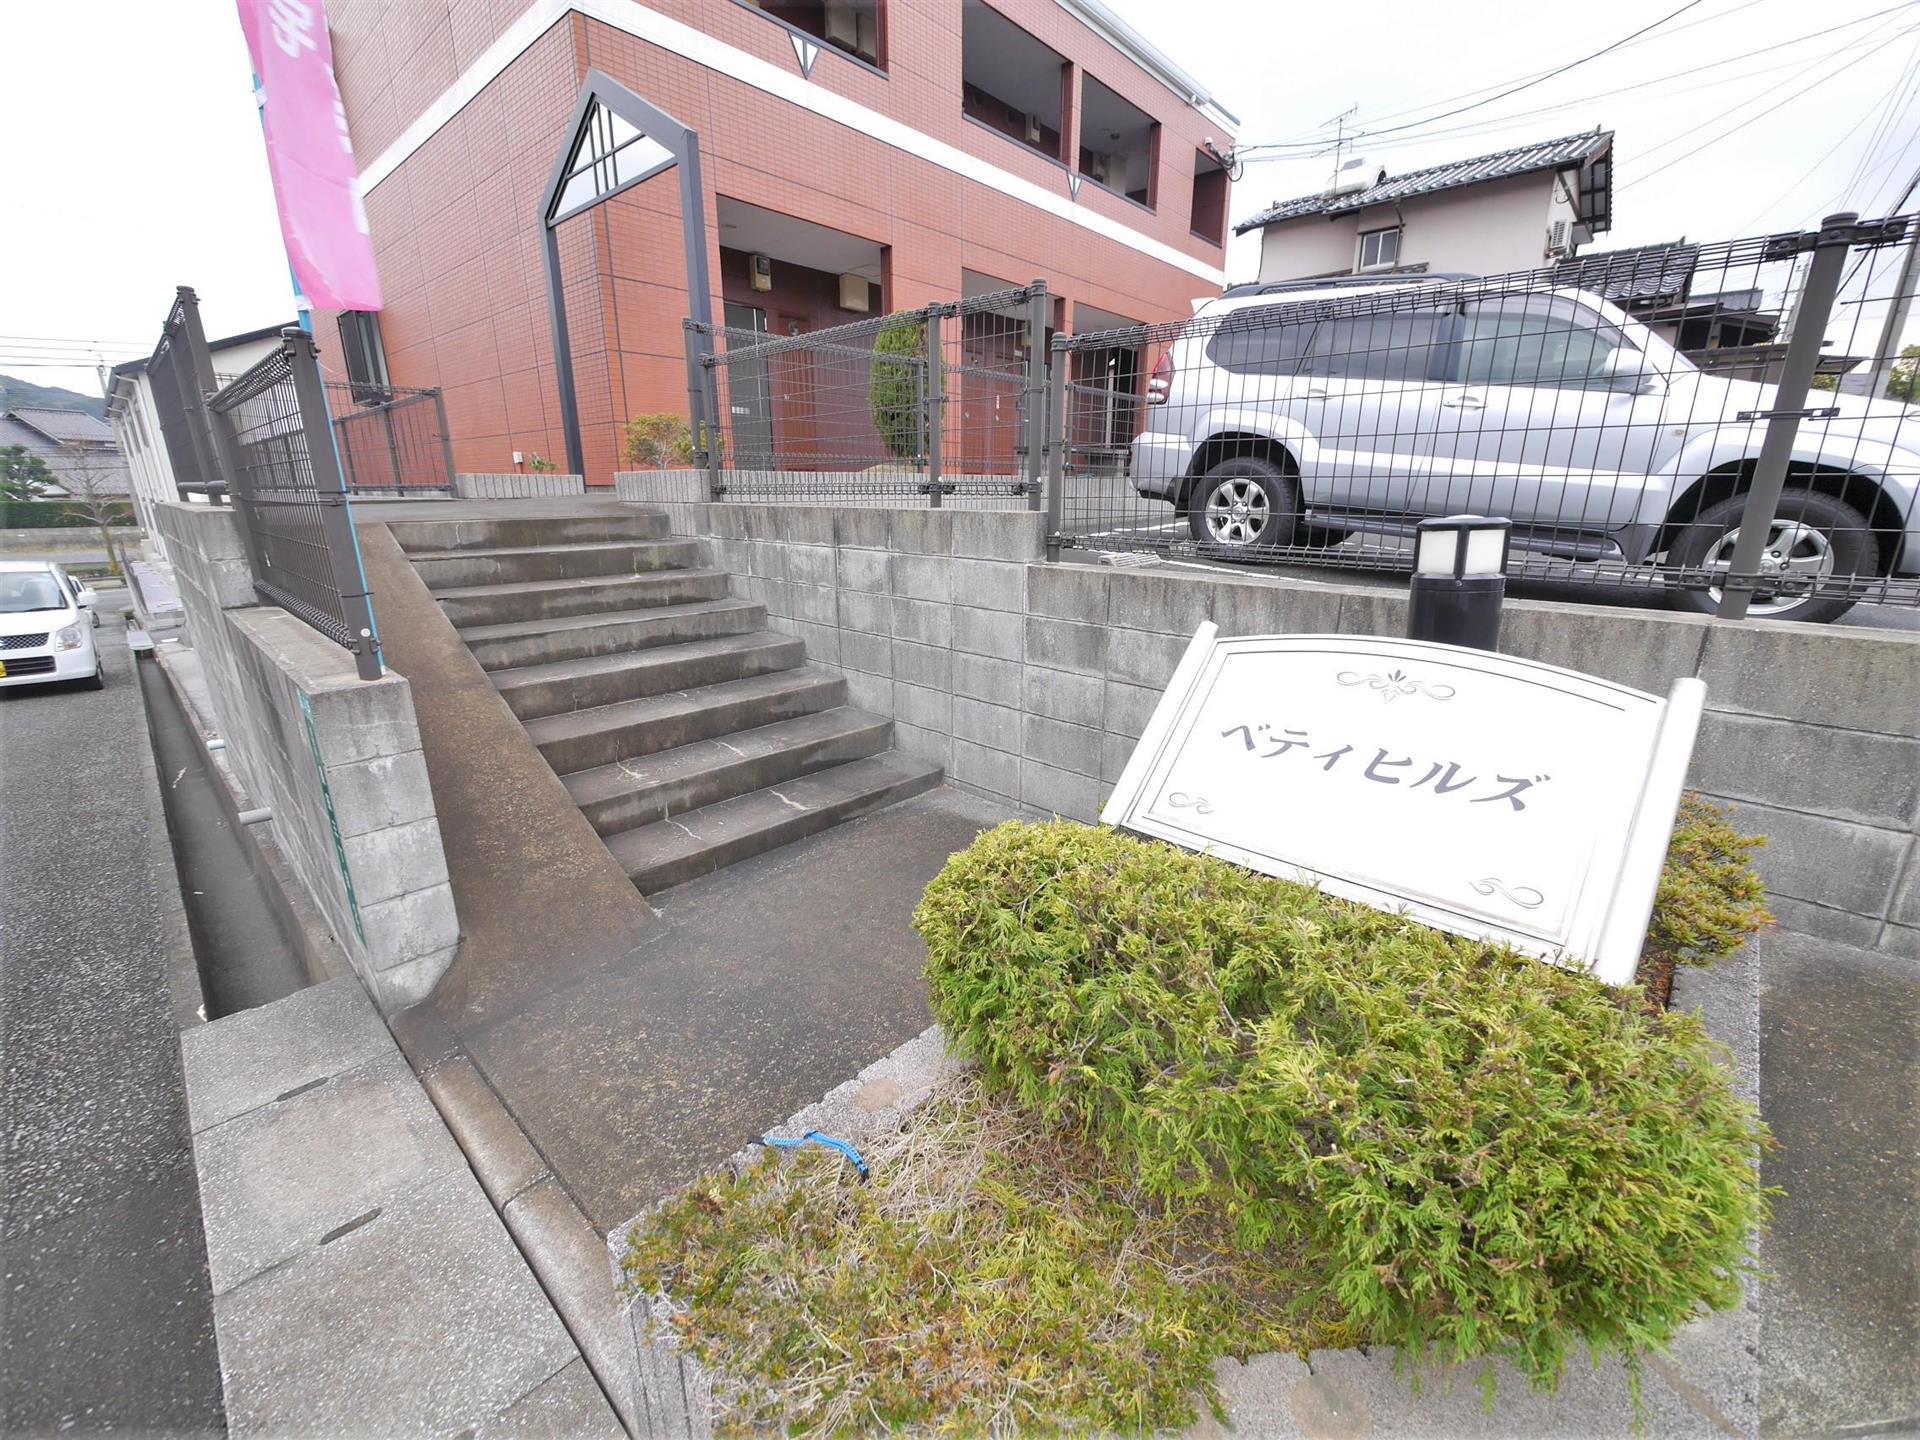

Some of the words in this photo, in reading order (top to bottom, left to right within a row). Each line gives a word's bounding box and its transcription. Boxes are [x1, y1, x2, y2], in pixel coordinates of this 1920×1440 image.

[1221, 723, 1551, 811] ベティヒルズ
